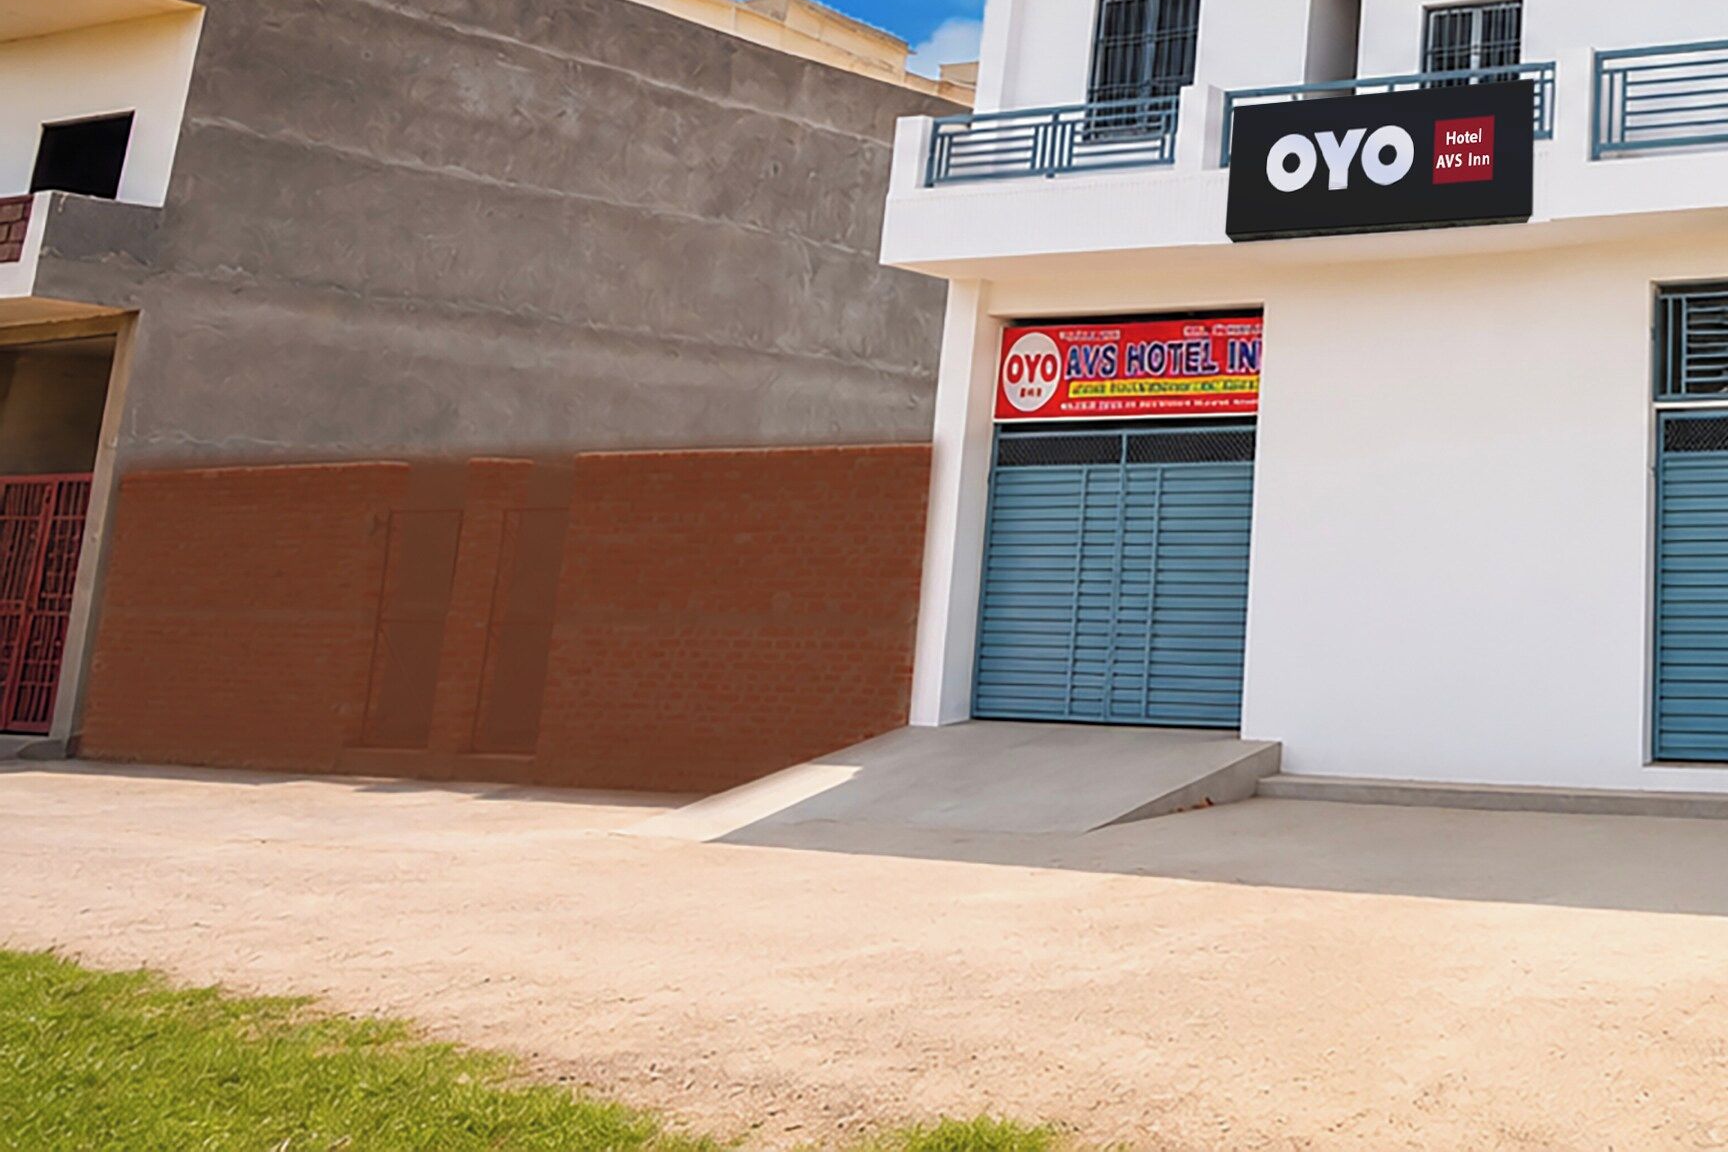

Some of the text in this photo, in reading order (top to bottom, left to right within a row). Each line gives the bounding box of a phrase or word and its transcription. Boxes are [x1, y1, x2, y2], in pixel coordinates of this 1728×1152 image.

[1445, 128, 1482, 146] Hotel
[1266, 125, 1414, 192] OYO
[1435, 152, 1490, 169] AVS Inn
[1007, 353, 1058, 384] OYO
[1064, 342, 1117, 380] AVS
[1125, 338, 1219, 377] HOTEL
